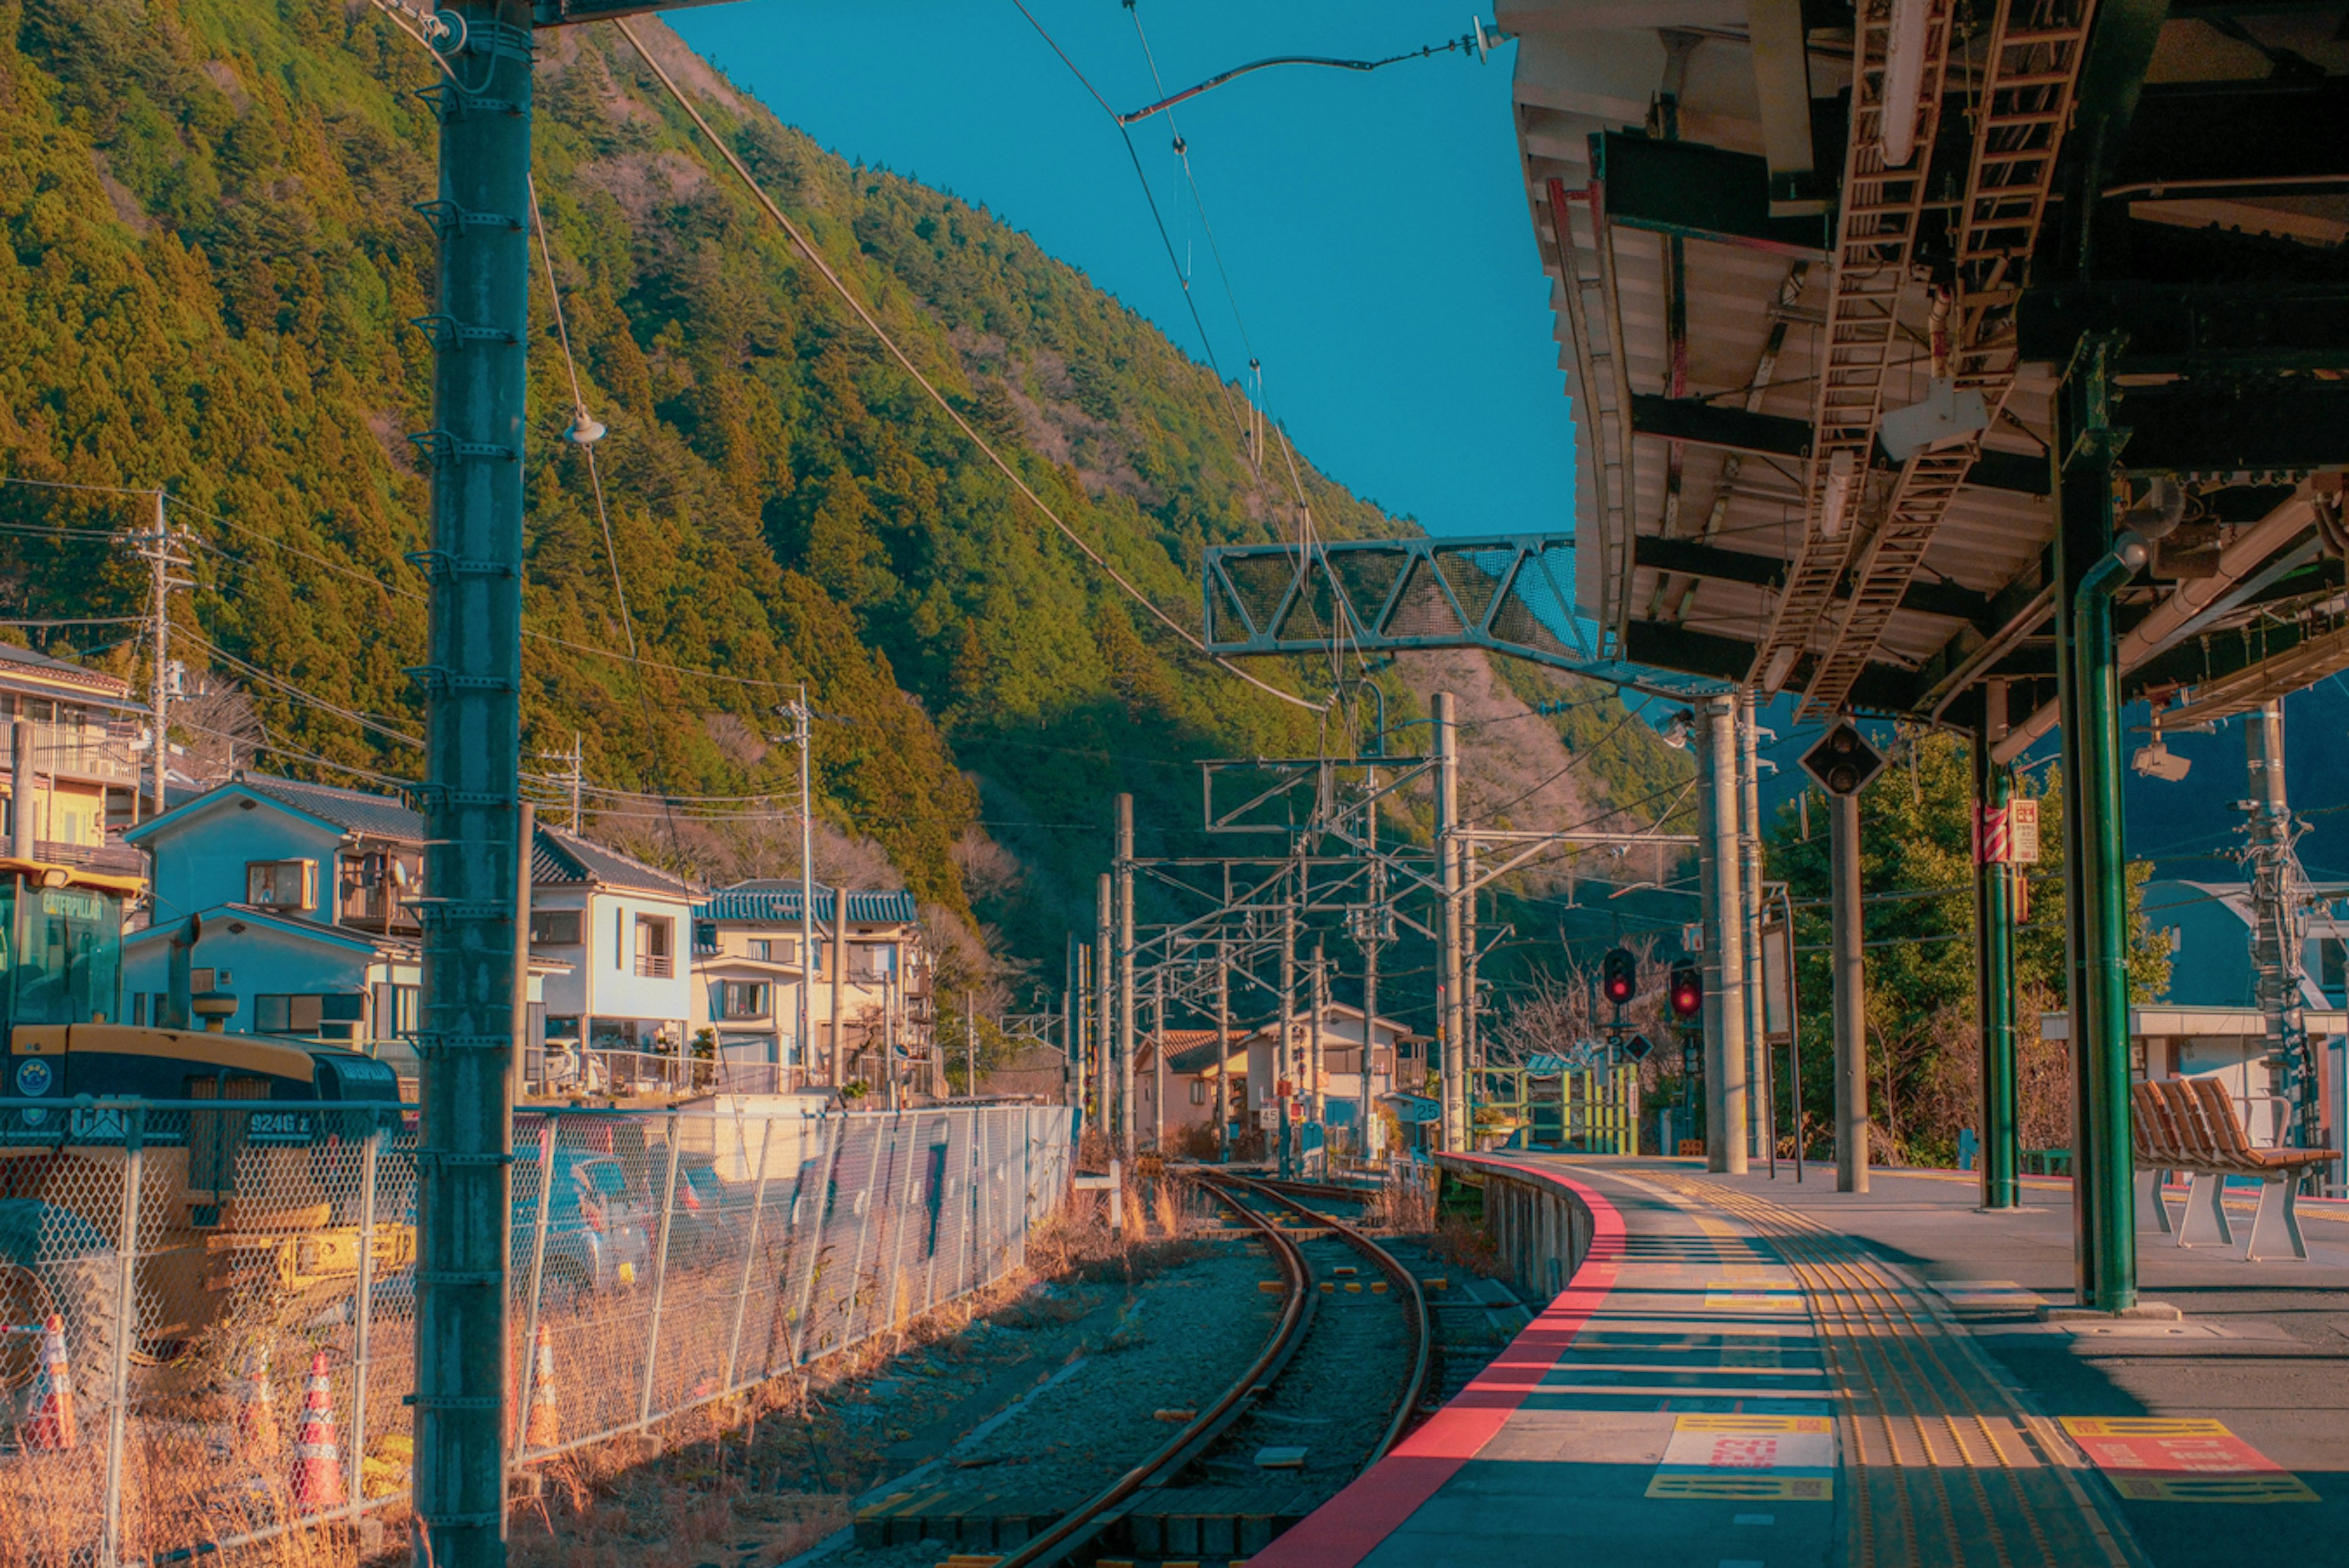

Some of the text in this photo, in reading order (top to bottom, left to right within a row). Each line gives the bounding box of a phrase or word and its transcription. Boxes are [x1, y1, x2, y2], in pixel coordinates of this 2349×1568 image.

[43, 893, 102, 921] CATERPILLAR
[1262, 1110, 1278, 1121] 45
[1417, 1104, 1438, 1121] 25
[251, 1113, 295, 1132] 924G
